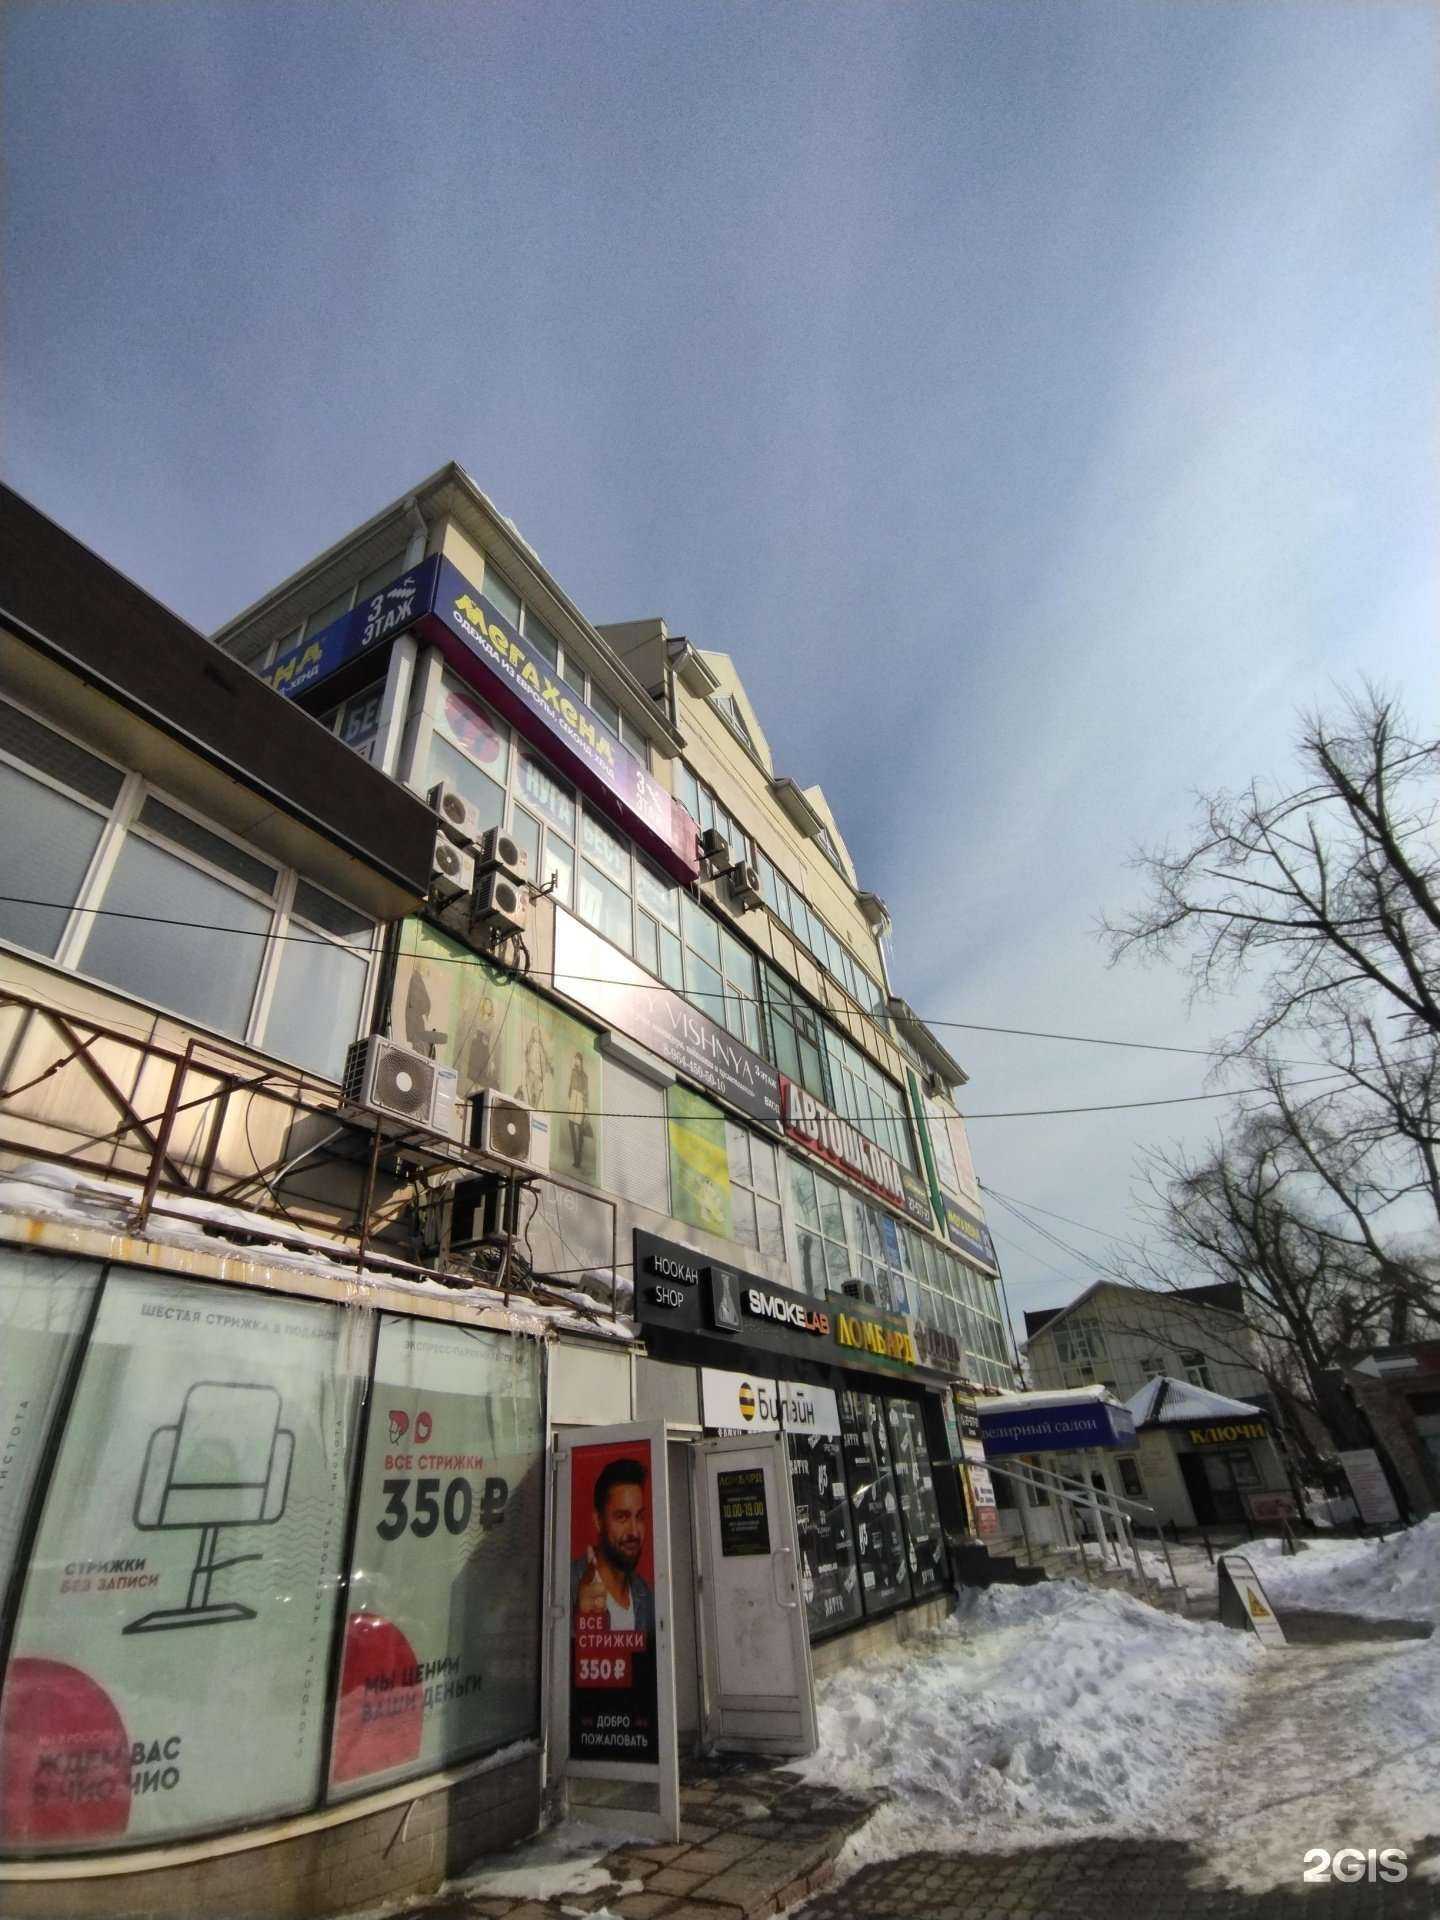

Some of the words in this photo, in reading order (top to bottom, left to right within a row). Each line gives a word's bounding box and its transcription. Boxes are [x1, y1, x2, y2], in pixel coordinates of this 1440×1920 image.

[362, 597, 415, 646] ЭТАЖ
[453, 611, 500, 662] ОДЕЖДА
[501, 661, 514, 677] ИЗ
[665, 1000, 754, 1086] VISHNYA
[787, 1081, 906, 1203] АВТОШКОЛА
[654, 1256, 699, 1285] HOOKAH
[656, 1286, 684, 1308] SHOP
[141, 1303, 201, 1322] ШЕСТАЯ
[206, 1314, 270, 1332] СТРИЖКА
[836, 1312, 916, 1366] ЛОМБАРД
[1056, 1419, 1098, 1433] салон
[1189, 1424, 1266, 1444] КЛЮЧИ
[384, 1454, 413, 1470] ВСЕ
[418, 1455, 484, 1470] СТРИЖКИ
[64, 1558, 147, 1575] СТРИЖКИ
[59, 1579, 92, 1594] БЕЗ
[98, 1574, 161, 1591] ЗАПИСИ
[578, 1616, 604, 1630] ВСЕ
[578, 1634, 645, 1649] СТРИЖКИ
[424, 1674, 483, 1710] ДЕНЬГИ
[596, 1715, 631, 1729] ДОБРО
[130, 1736, 182, 1766] ВАС
[580, 1733, 649, 1747] ПОЖАЛОВАТЬ
